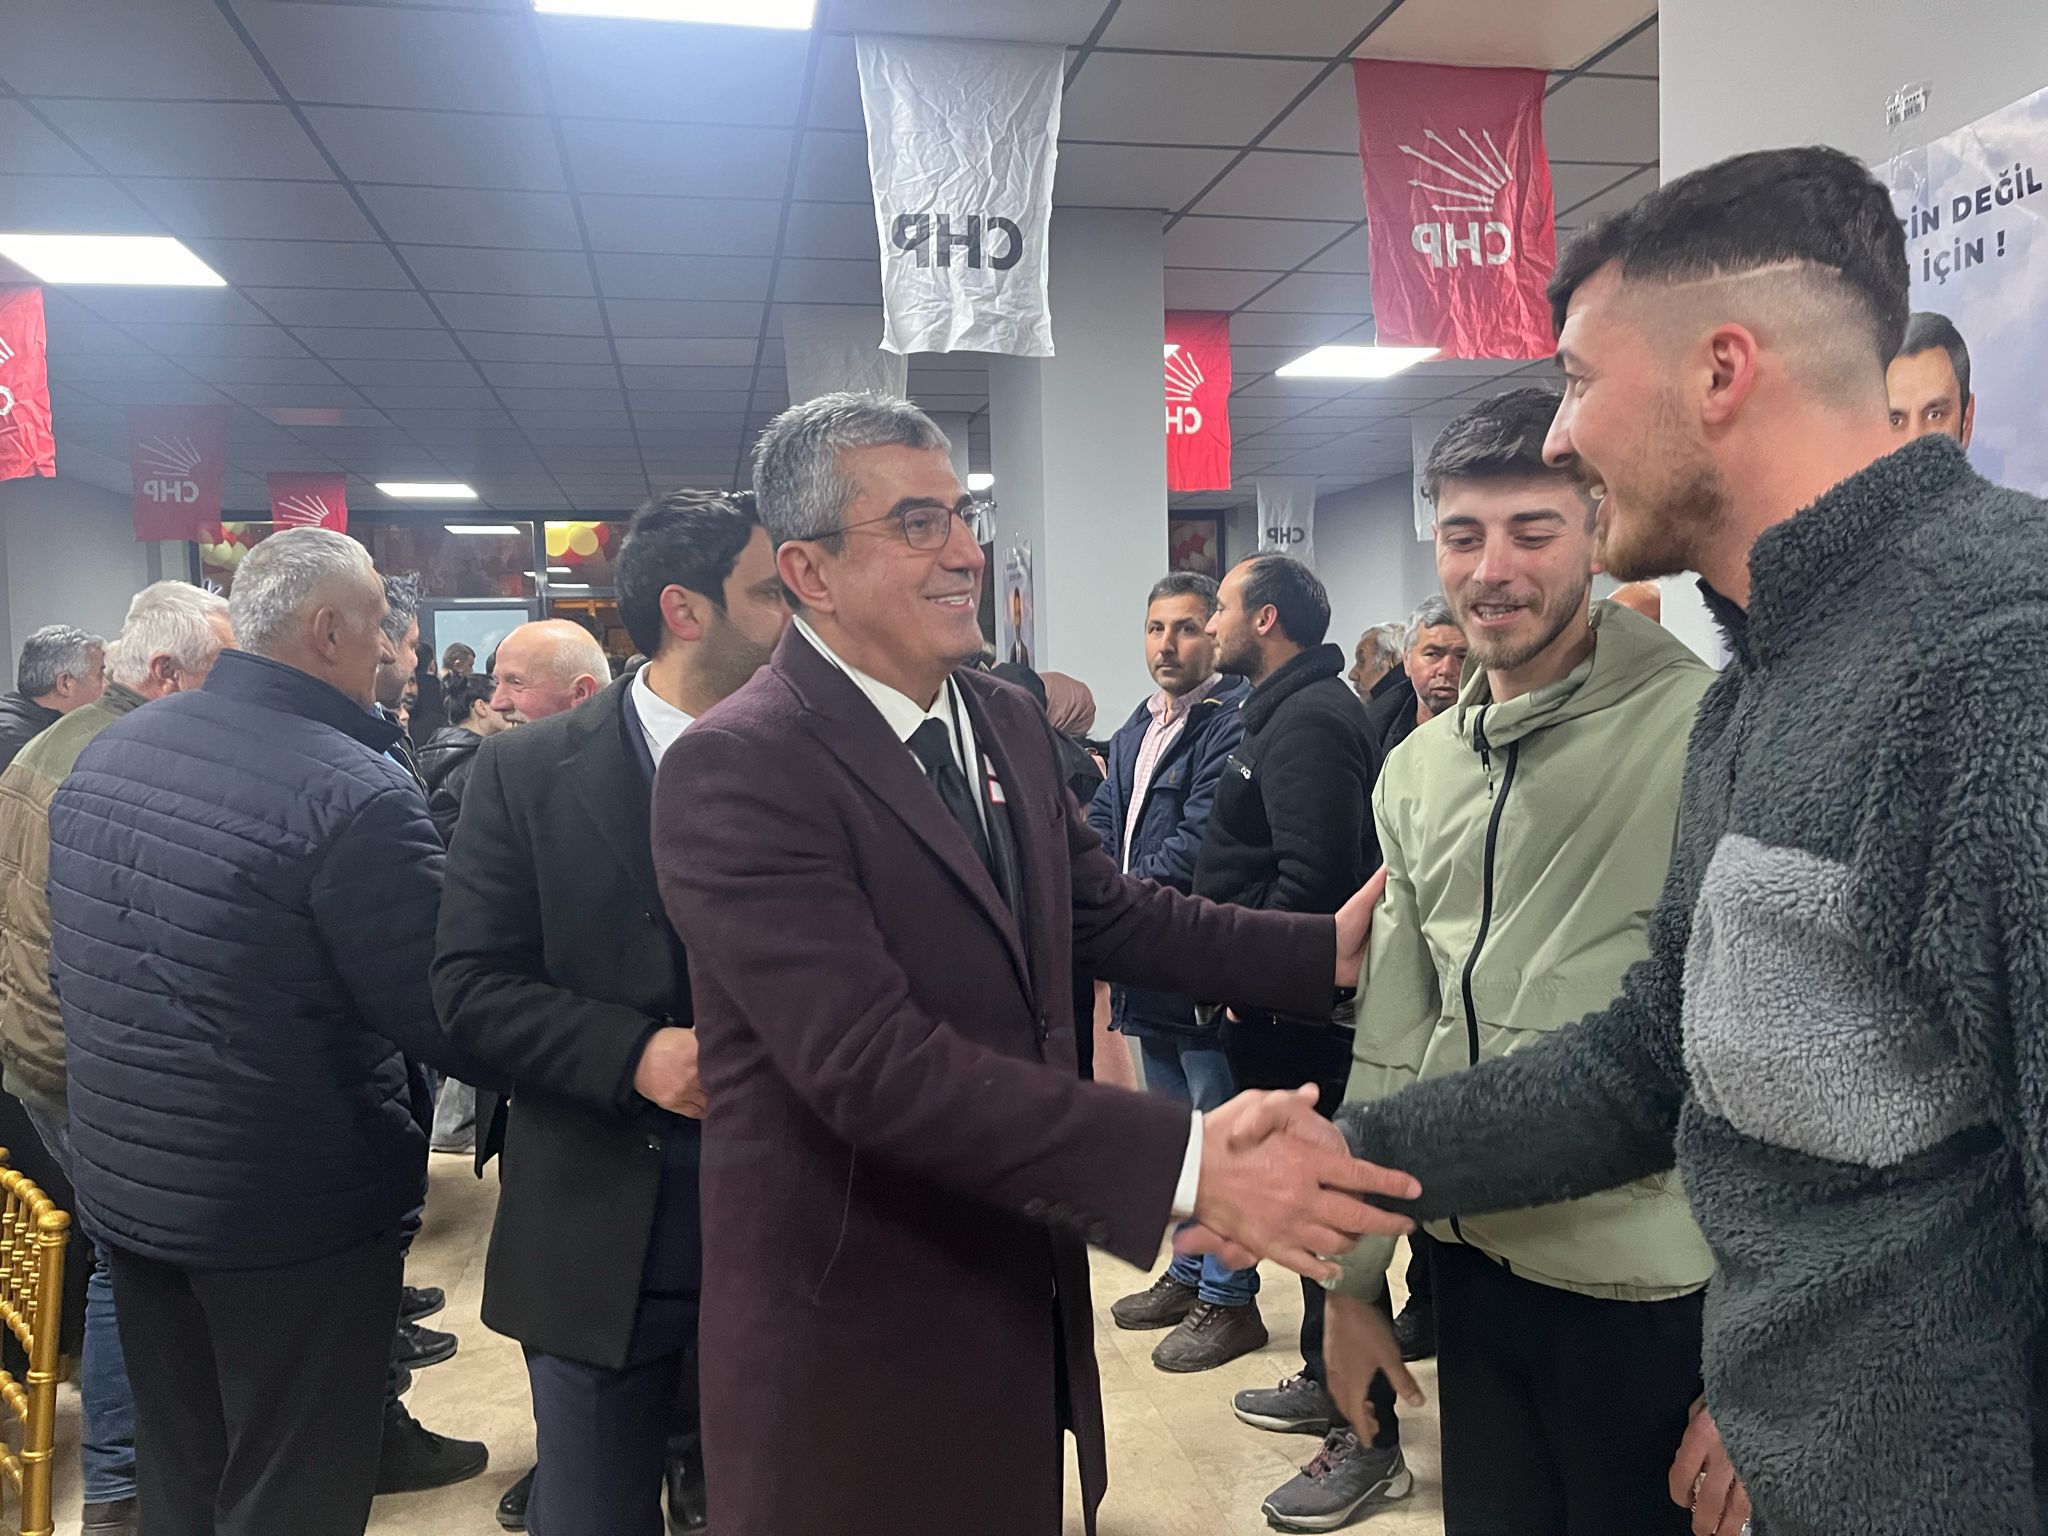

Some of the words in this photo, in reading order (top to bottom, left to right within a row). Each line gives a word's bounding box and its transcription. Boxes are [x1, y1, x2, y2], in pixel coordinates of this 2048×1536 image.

[1901, 205, 1940, 240] İN
[1952, 162, 2043, 224] DEĞİL
[1923, 237, 1984, 286] İÇİN
